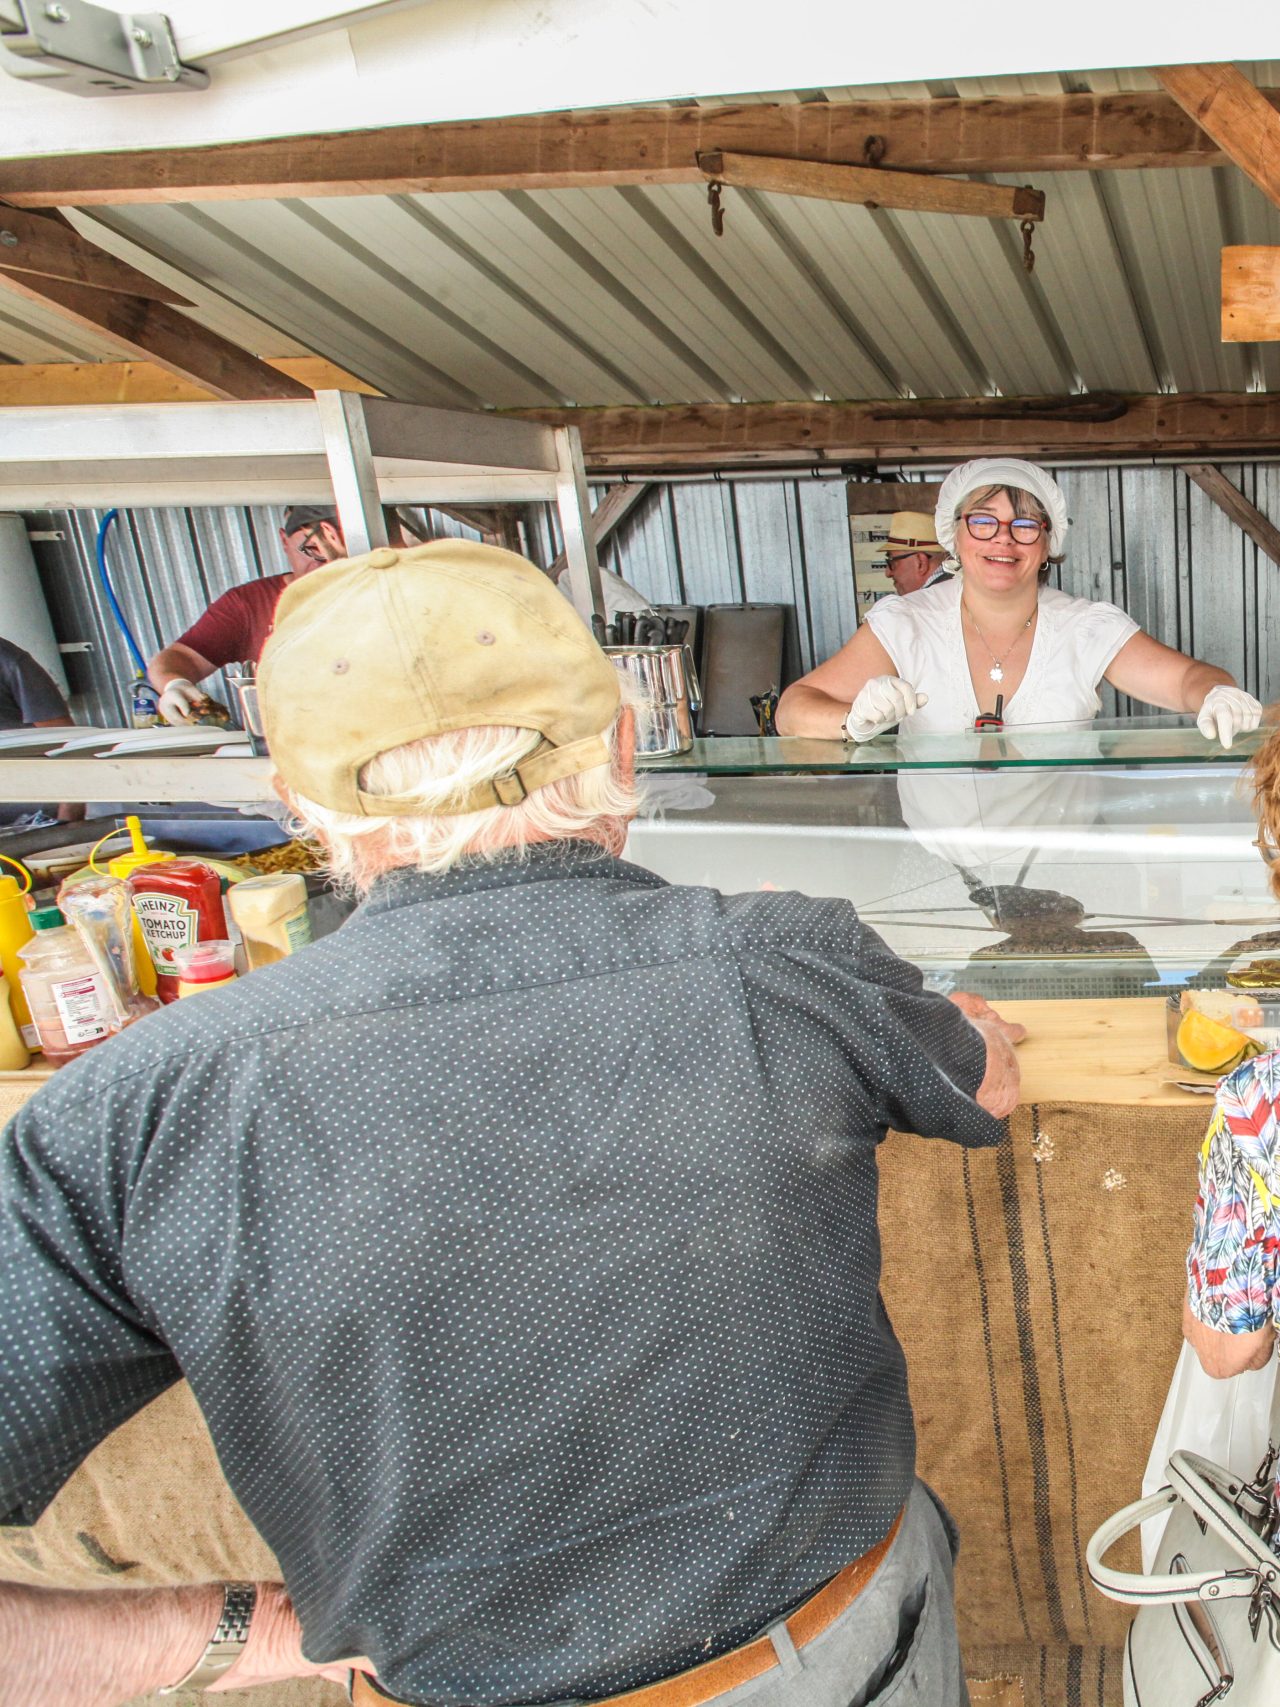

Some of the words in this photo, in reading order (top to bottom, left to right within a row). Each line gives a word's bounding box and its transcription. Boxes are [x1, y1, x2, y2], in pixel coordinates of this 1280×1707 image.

[141, 900, 176, 913] HEINZ
[141, 917, 186, 931] TOMATO
[146, 929, 186, 940] KETCHUP
